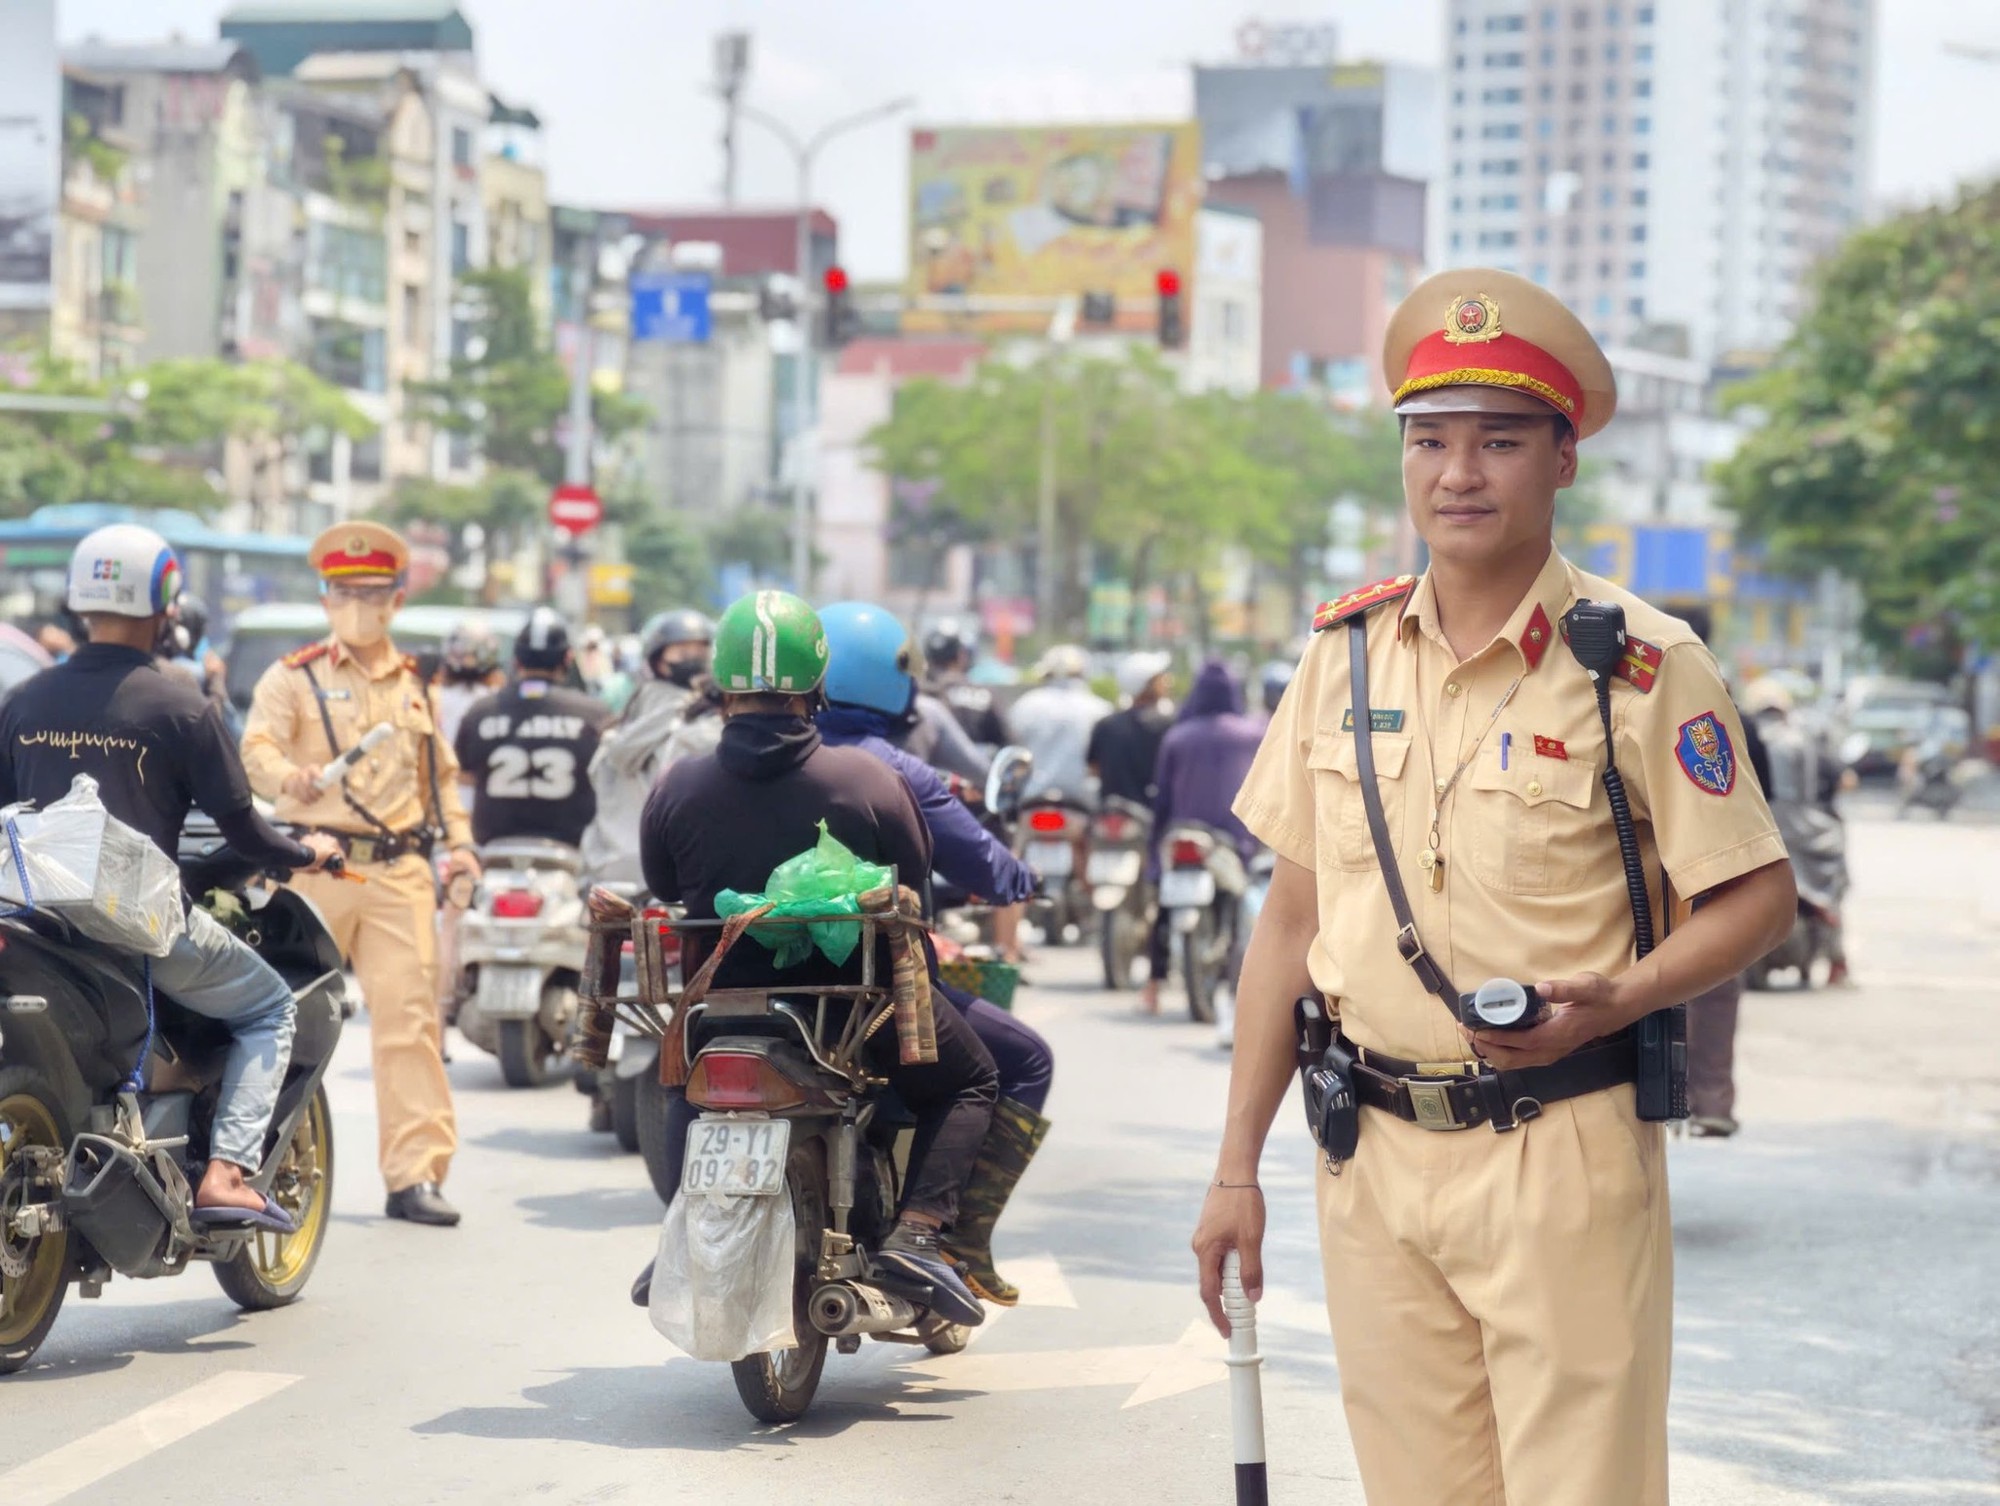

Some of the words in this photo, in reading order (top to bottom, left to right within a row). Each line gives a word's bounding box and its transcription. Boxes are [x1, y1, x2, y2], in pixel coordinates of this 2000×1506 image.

[486, 744, 577, 800] 23
[1694, 750, 1729, 775] CSGT
[700, 1125, 773, 1156] 29-Y1
